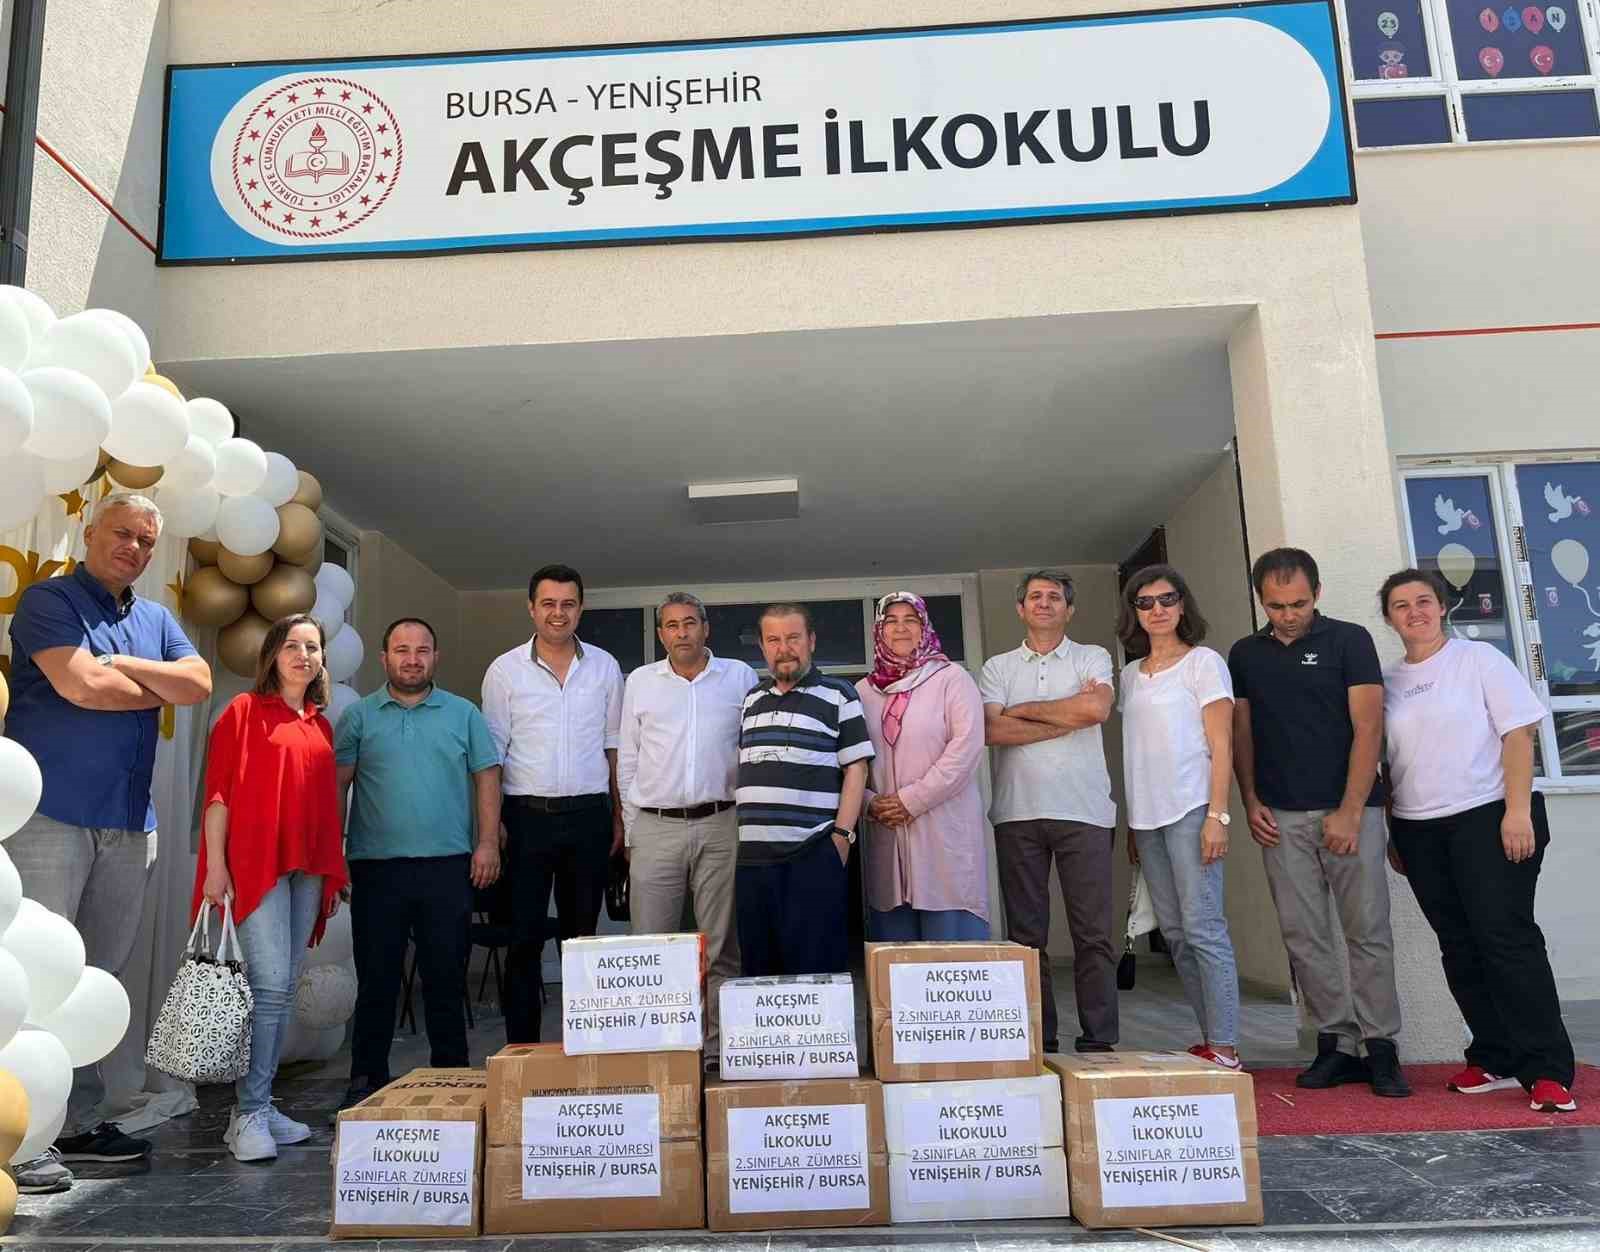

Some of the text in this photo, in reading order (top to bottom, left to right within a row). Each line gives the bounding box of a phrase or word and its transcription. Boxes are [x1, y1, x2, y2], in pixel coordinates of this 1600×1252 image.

[446, 87, 557, 119] BURSA
[587, 71, 762, 113] YENİŞEHİR
[264, 106, 371, 207] TÜRKİYE CUMHURİYETİ MİLLİ EĞİTİM BAKANLIĞI
[445, 99, 1211, 206] AKÇEŞME İLKOKULU
[597, 953, 661, 970] AKÇEŞME
[597, 974, 663, 990] İLKOKULU
[926, 969, 989, 985] AKÇEŞME
[569, 992, 693, 1010] 2.SINIFLAR ZÜMRESİ
[756, 993, 819, 1009] AKÇEŞME
[926, 989, 992, 1003] İLKOKULU
[567, 1011, 696, 1031] YENİŞEHİR / BURSA
[755, 1013, 821, 1027] İLKOKULU
[898, 1008, 1021, 1022] 2.SINIFLAR ZÜMRESİ
[728, 1032, 851, 1047] 2.SINIFLAR ZÜMRESİ
[896, 1028, 1025, 1044] YENİŞEHİR / BURSA
[726, 1051, 855, 1068] YENİŞEHİR / BURSA
[559, 1103, 623, 1119] AKÇEŞME
[939, 1104, 1004, 1120] AKÇEŞME
[1133, 1104, 1199, 1119] AKÇEŞME
[765, 1113, 830, 1129] AKÇEŞME
[376, 1129, 440, 1143] AKÇEŞME
[557, 1123, 624, 1138] İLKOKULU
[939, 1125, 1007, 1140] İLKOKULU
[1133, 1126, 1202, 1140] İLKOKULU
[764, 1133, 832, 1148] İLKOKULU
[373, 1147, 439, 1162] İLKOKULU
[528, 1143, 653, 1156] 2.SINIFLAR ZÜMRESİ
[912, 1146, 1038, 1161] 2.SINIFLAR ZÜMRESİ
[1106, 1147, 1235, 1162] 2.SINIFLAR ZÜMRESİ
[736, 1154, 861, 1169] 2.SINIFLAR ZÜMRESİ
[344, 1169, 467, 1182] 2.SINIFLAR ZÜMRESİ
[526, 1163, 657, 1179] YENİŞEHİR / BURSA
[910, 1165, 1042, 1182] YENİŞEHİR / BURSA
[1104, 1166, 1240, 1185] YENİŞEHİR / BURSA
[733, 1175, 865, 1191] YENİŞEHİR / BURSA
[340, 1190, 469, 1204] YENİŞEHİR / BURSA
